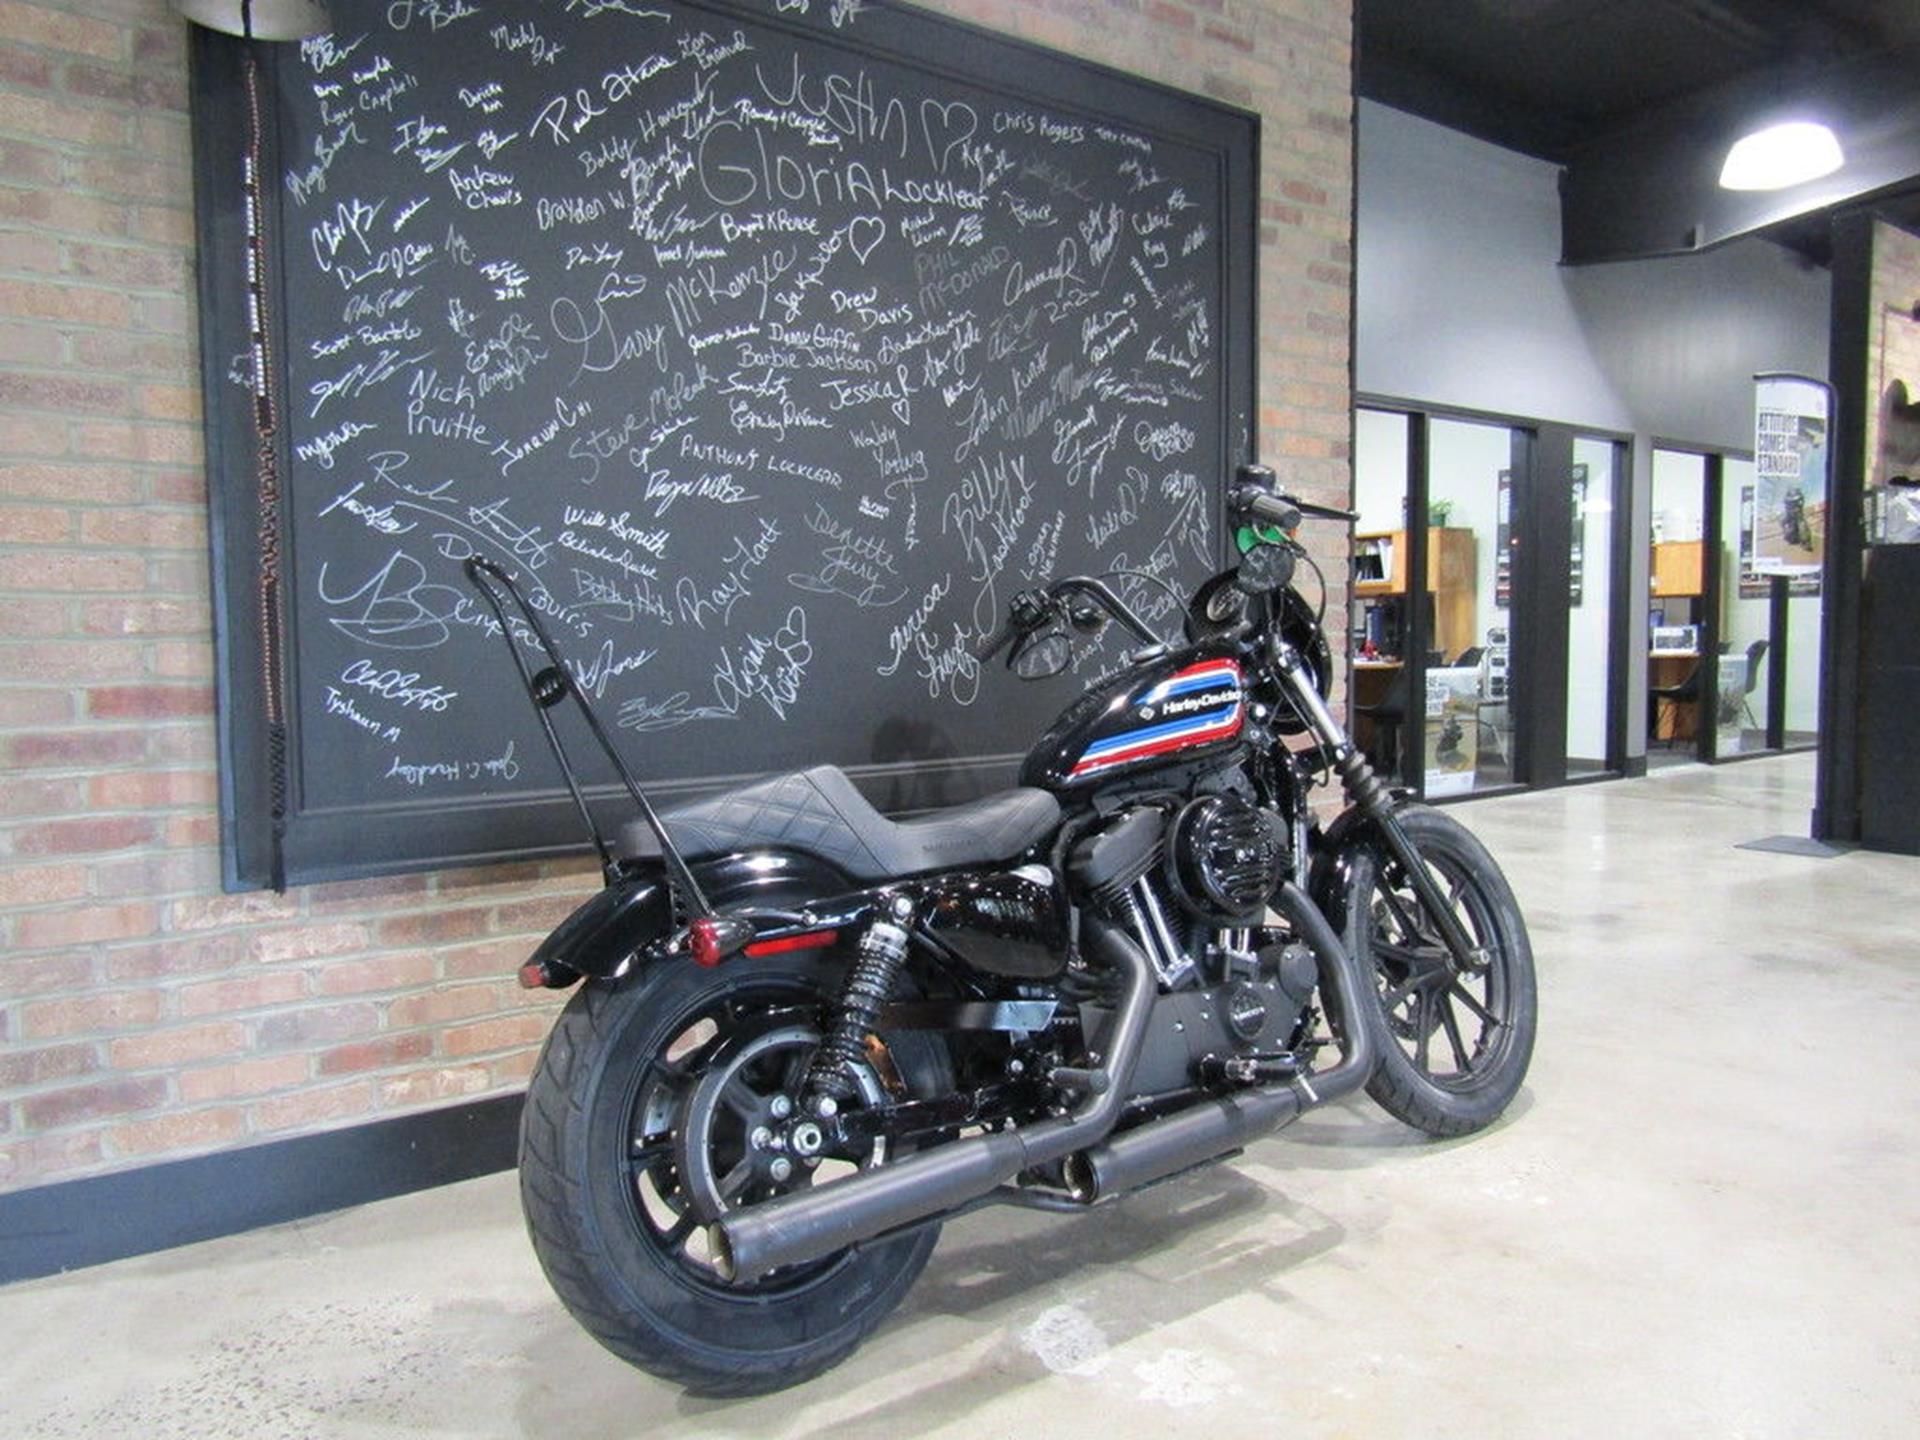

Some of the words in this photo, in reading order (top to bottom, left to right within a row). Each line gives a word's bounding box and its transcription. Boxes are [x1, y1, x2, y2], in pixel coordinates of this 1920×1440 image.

[993, 112, 1035, 133] Chris
[821, 380, 900, 411] Jessica
[1162, 689, 1246, 716] Harley-Davidso
